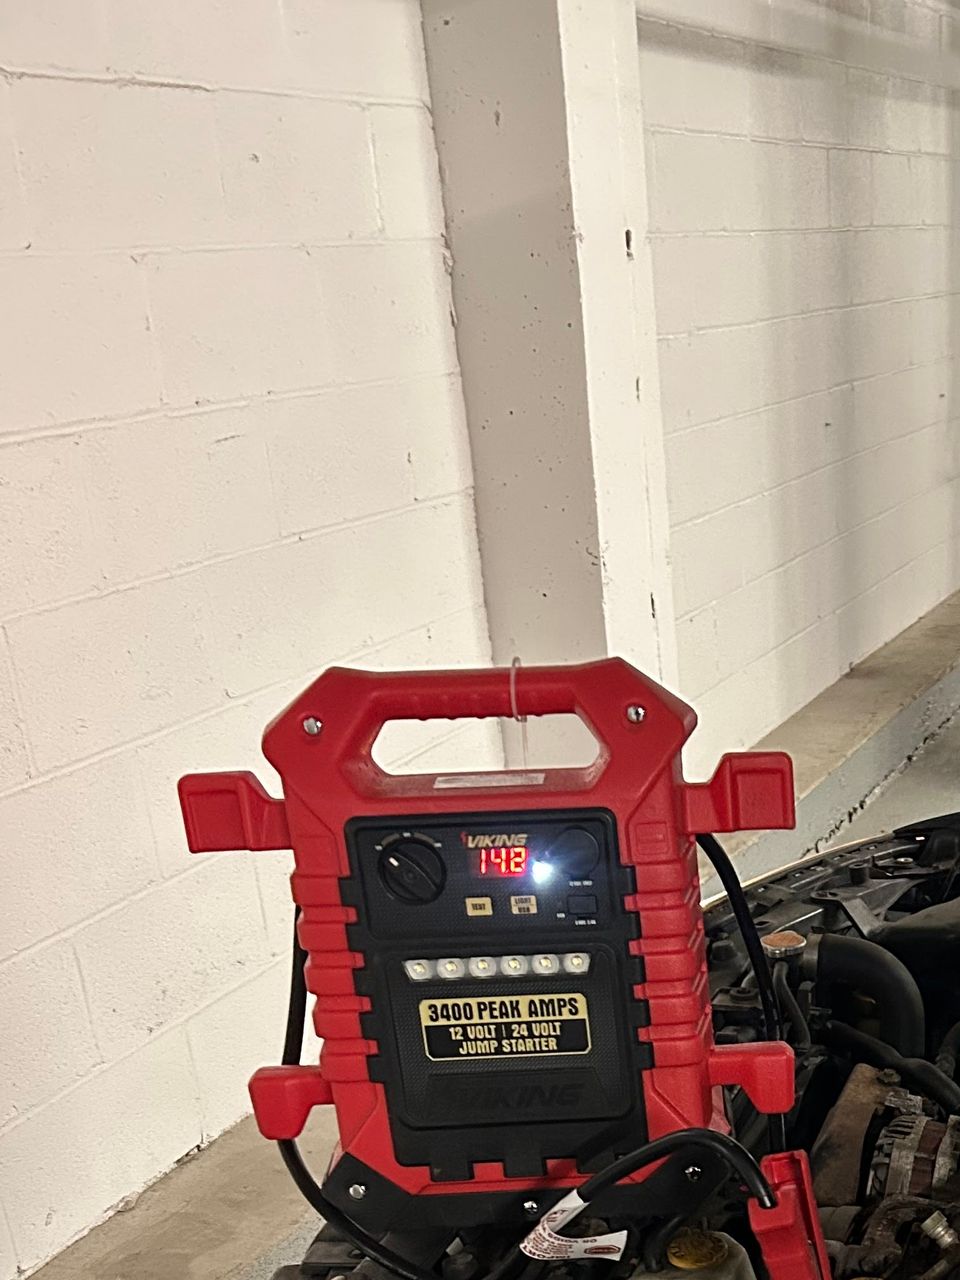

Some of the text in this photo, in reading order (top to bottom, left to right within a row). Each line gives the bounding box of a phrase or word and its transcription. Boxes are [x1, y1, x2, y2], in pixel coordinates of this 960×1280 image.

[467, 834, 528, 848] VIKING
[428, 998, 579, 1022] 3400 PEAK AMPS
[449, 1022, 561, 1040] 12 VOLT 24 VOLT
[459, 1038, 558, 1055] JUMP STARTER
